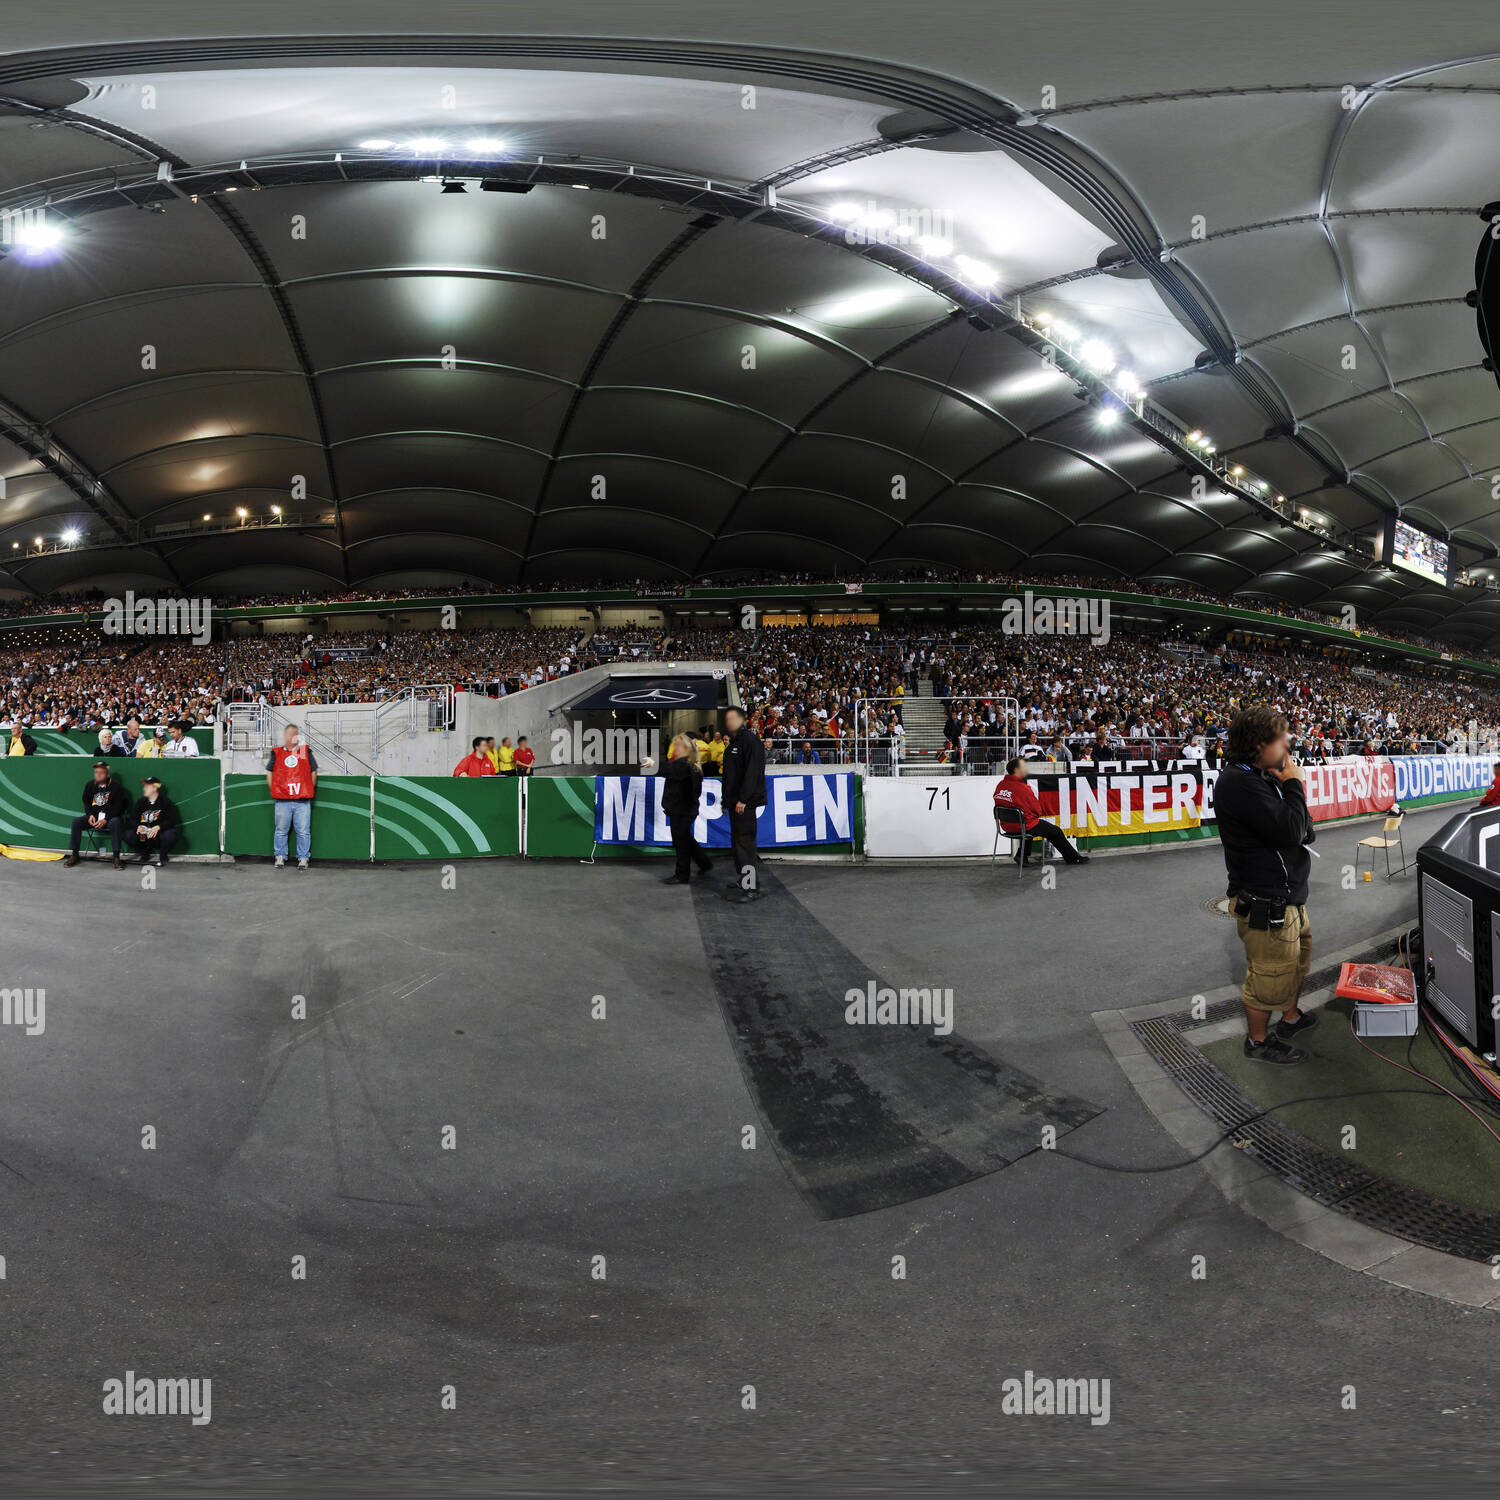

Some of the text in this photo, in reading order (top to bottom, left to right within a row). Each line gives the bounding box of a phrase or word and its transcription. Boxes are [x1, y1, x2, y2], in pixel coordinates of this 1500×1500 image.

[288, 783, 301, 795] TV
[925, 787, 950, 811] 71
[602, 773, 851, 843] MPEN
